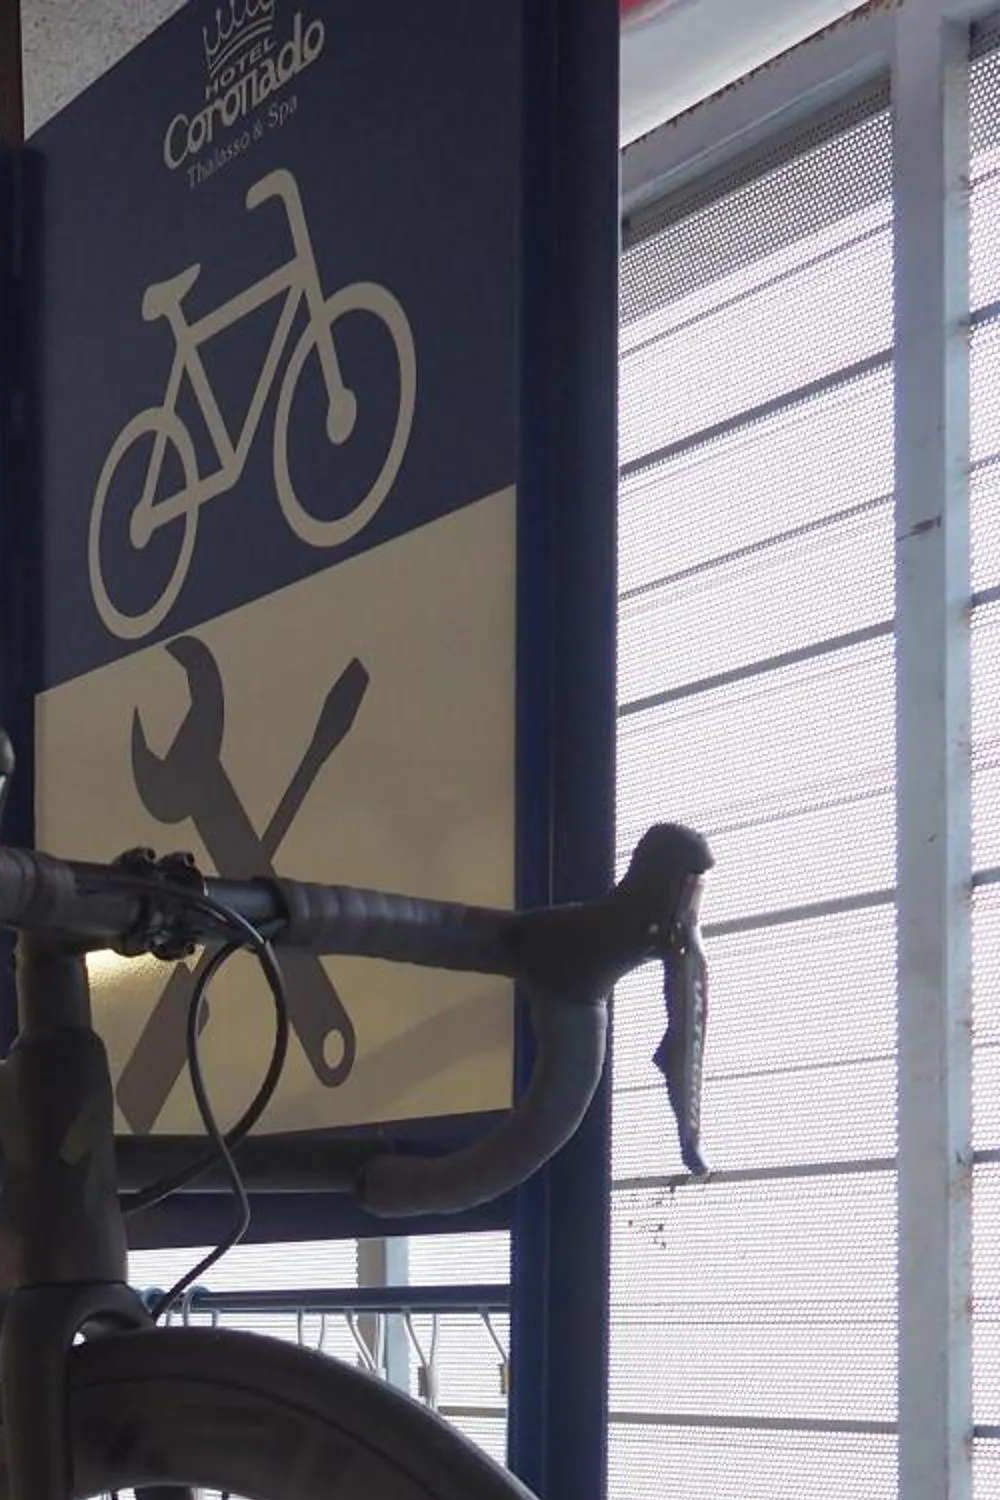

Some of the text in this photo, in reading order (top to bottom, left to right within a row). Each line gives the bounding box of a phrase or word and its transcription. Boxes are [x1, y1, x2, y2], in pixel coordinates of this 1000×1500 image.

[163, 11, 326, 170] Coronado
[205, 38, 276, 99] HOTEL
[268, 95, 298, 129] Spa
